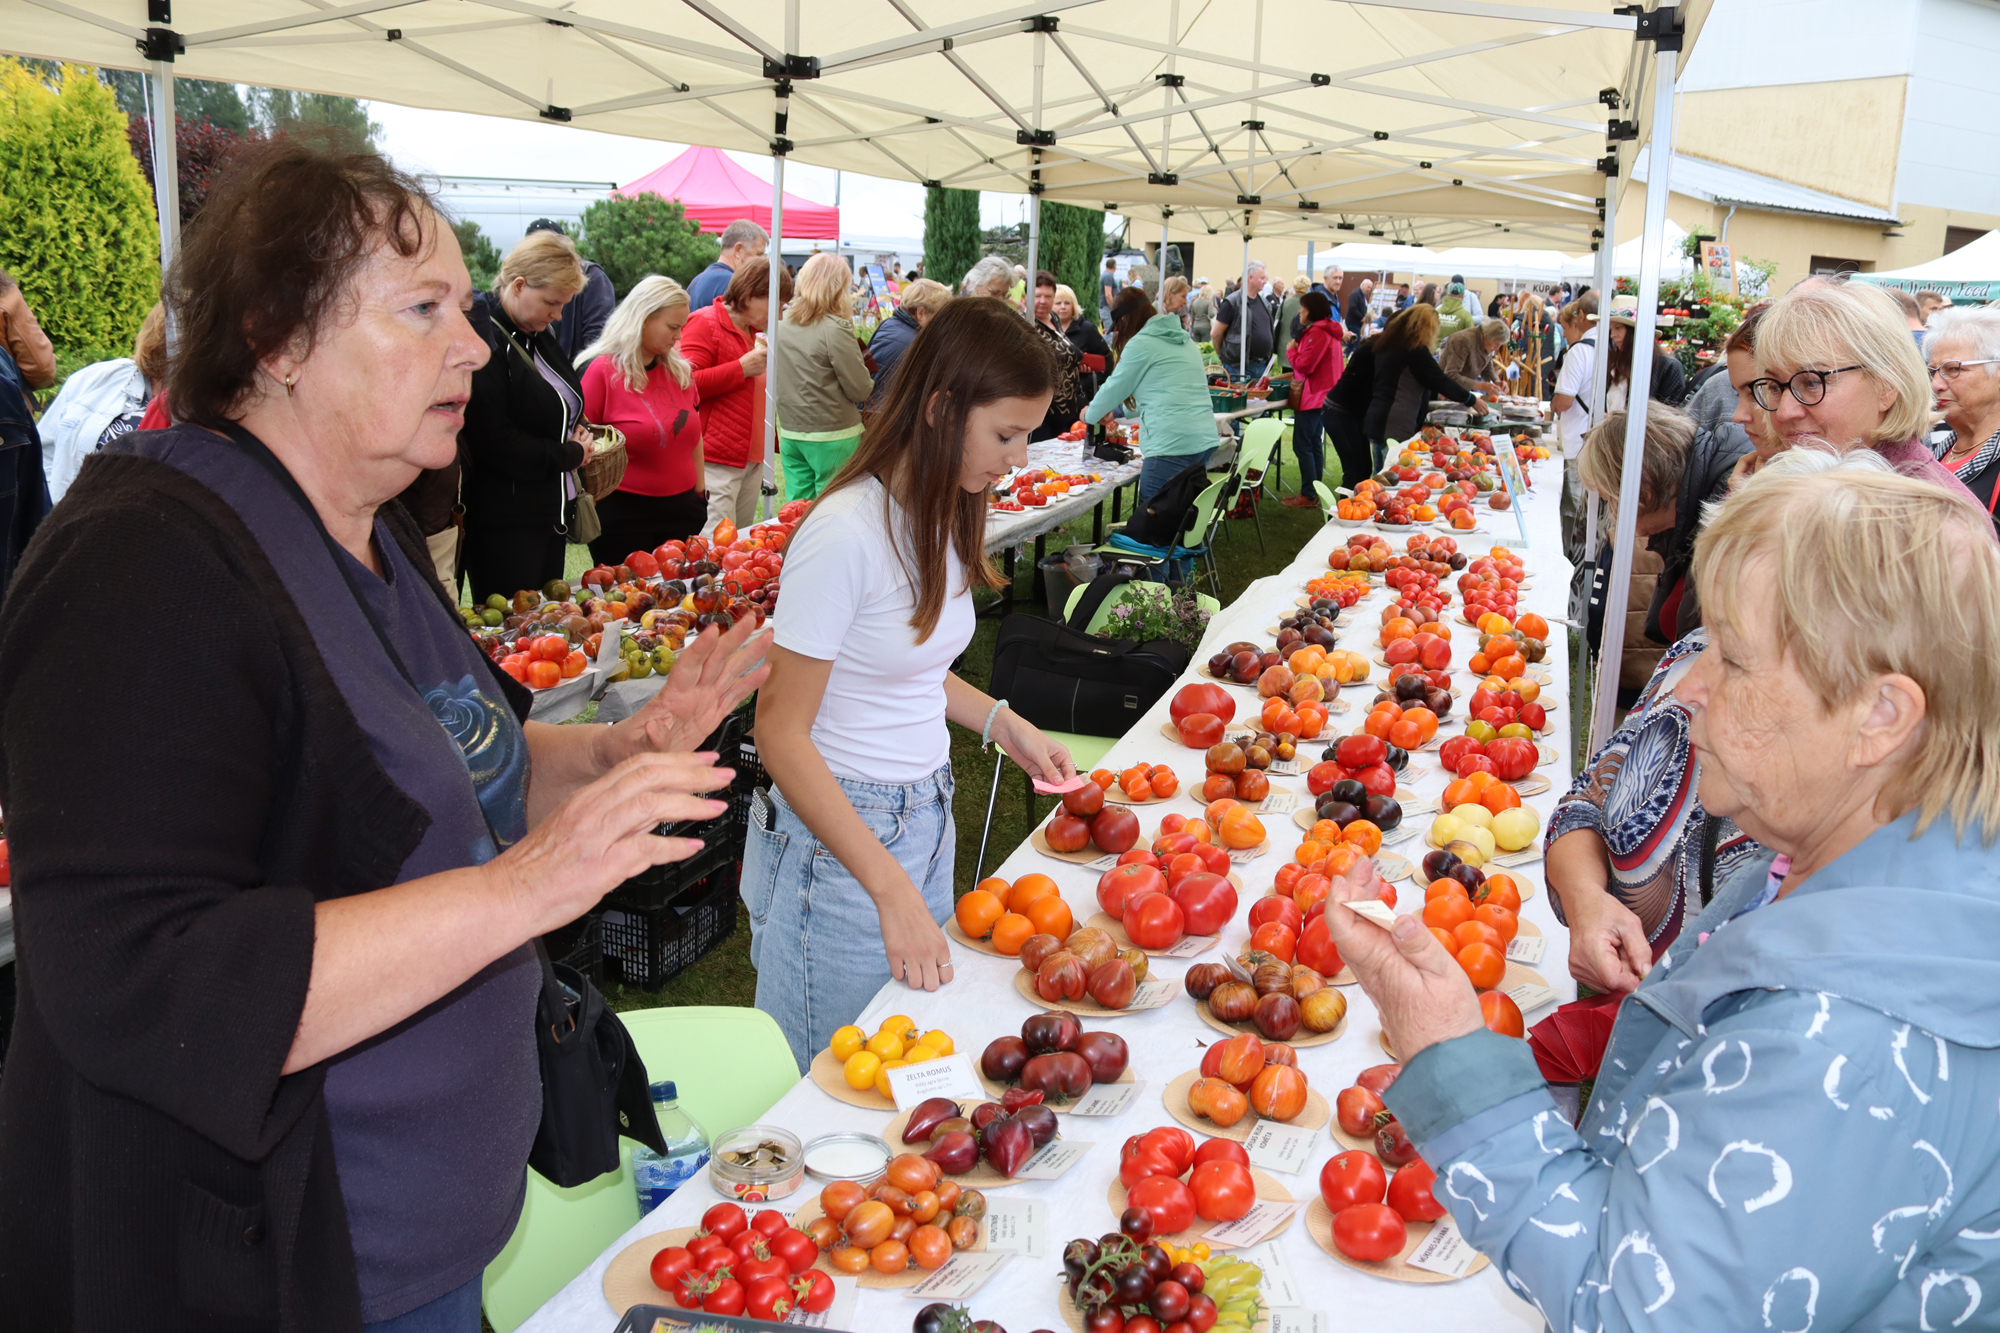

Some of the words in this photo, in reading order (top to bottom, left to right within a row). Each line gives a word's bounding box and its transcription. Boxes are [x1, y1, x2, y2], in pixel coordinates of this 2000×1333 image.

[1907, 280, 1953, 297] Italian
[1957, 282, 1991, 297] Food
[905, 1071, 926, 1082] ZELTA
[926, 1065, 952, 1077] ROMUS
[1259, 1131, 1273, 1149] KOMĒTA
[1433, 1226, 1450, 1244] DĀVANA
